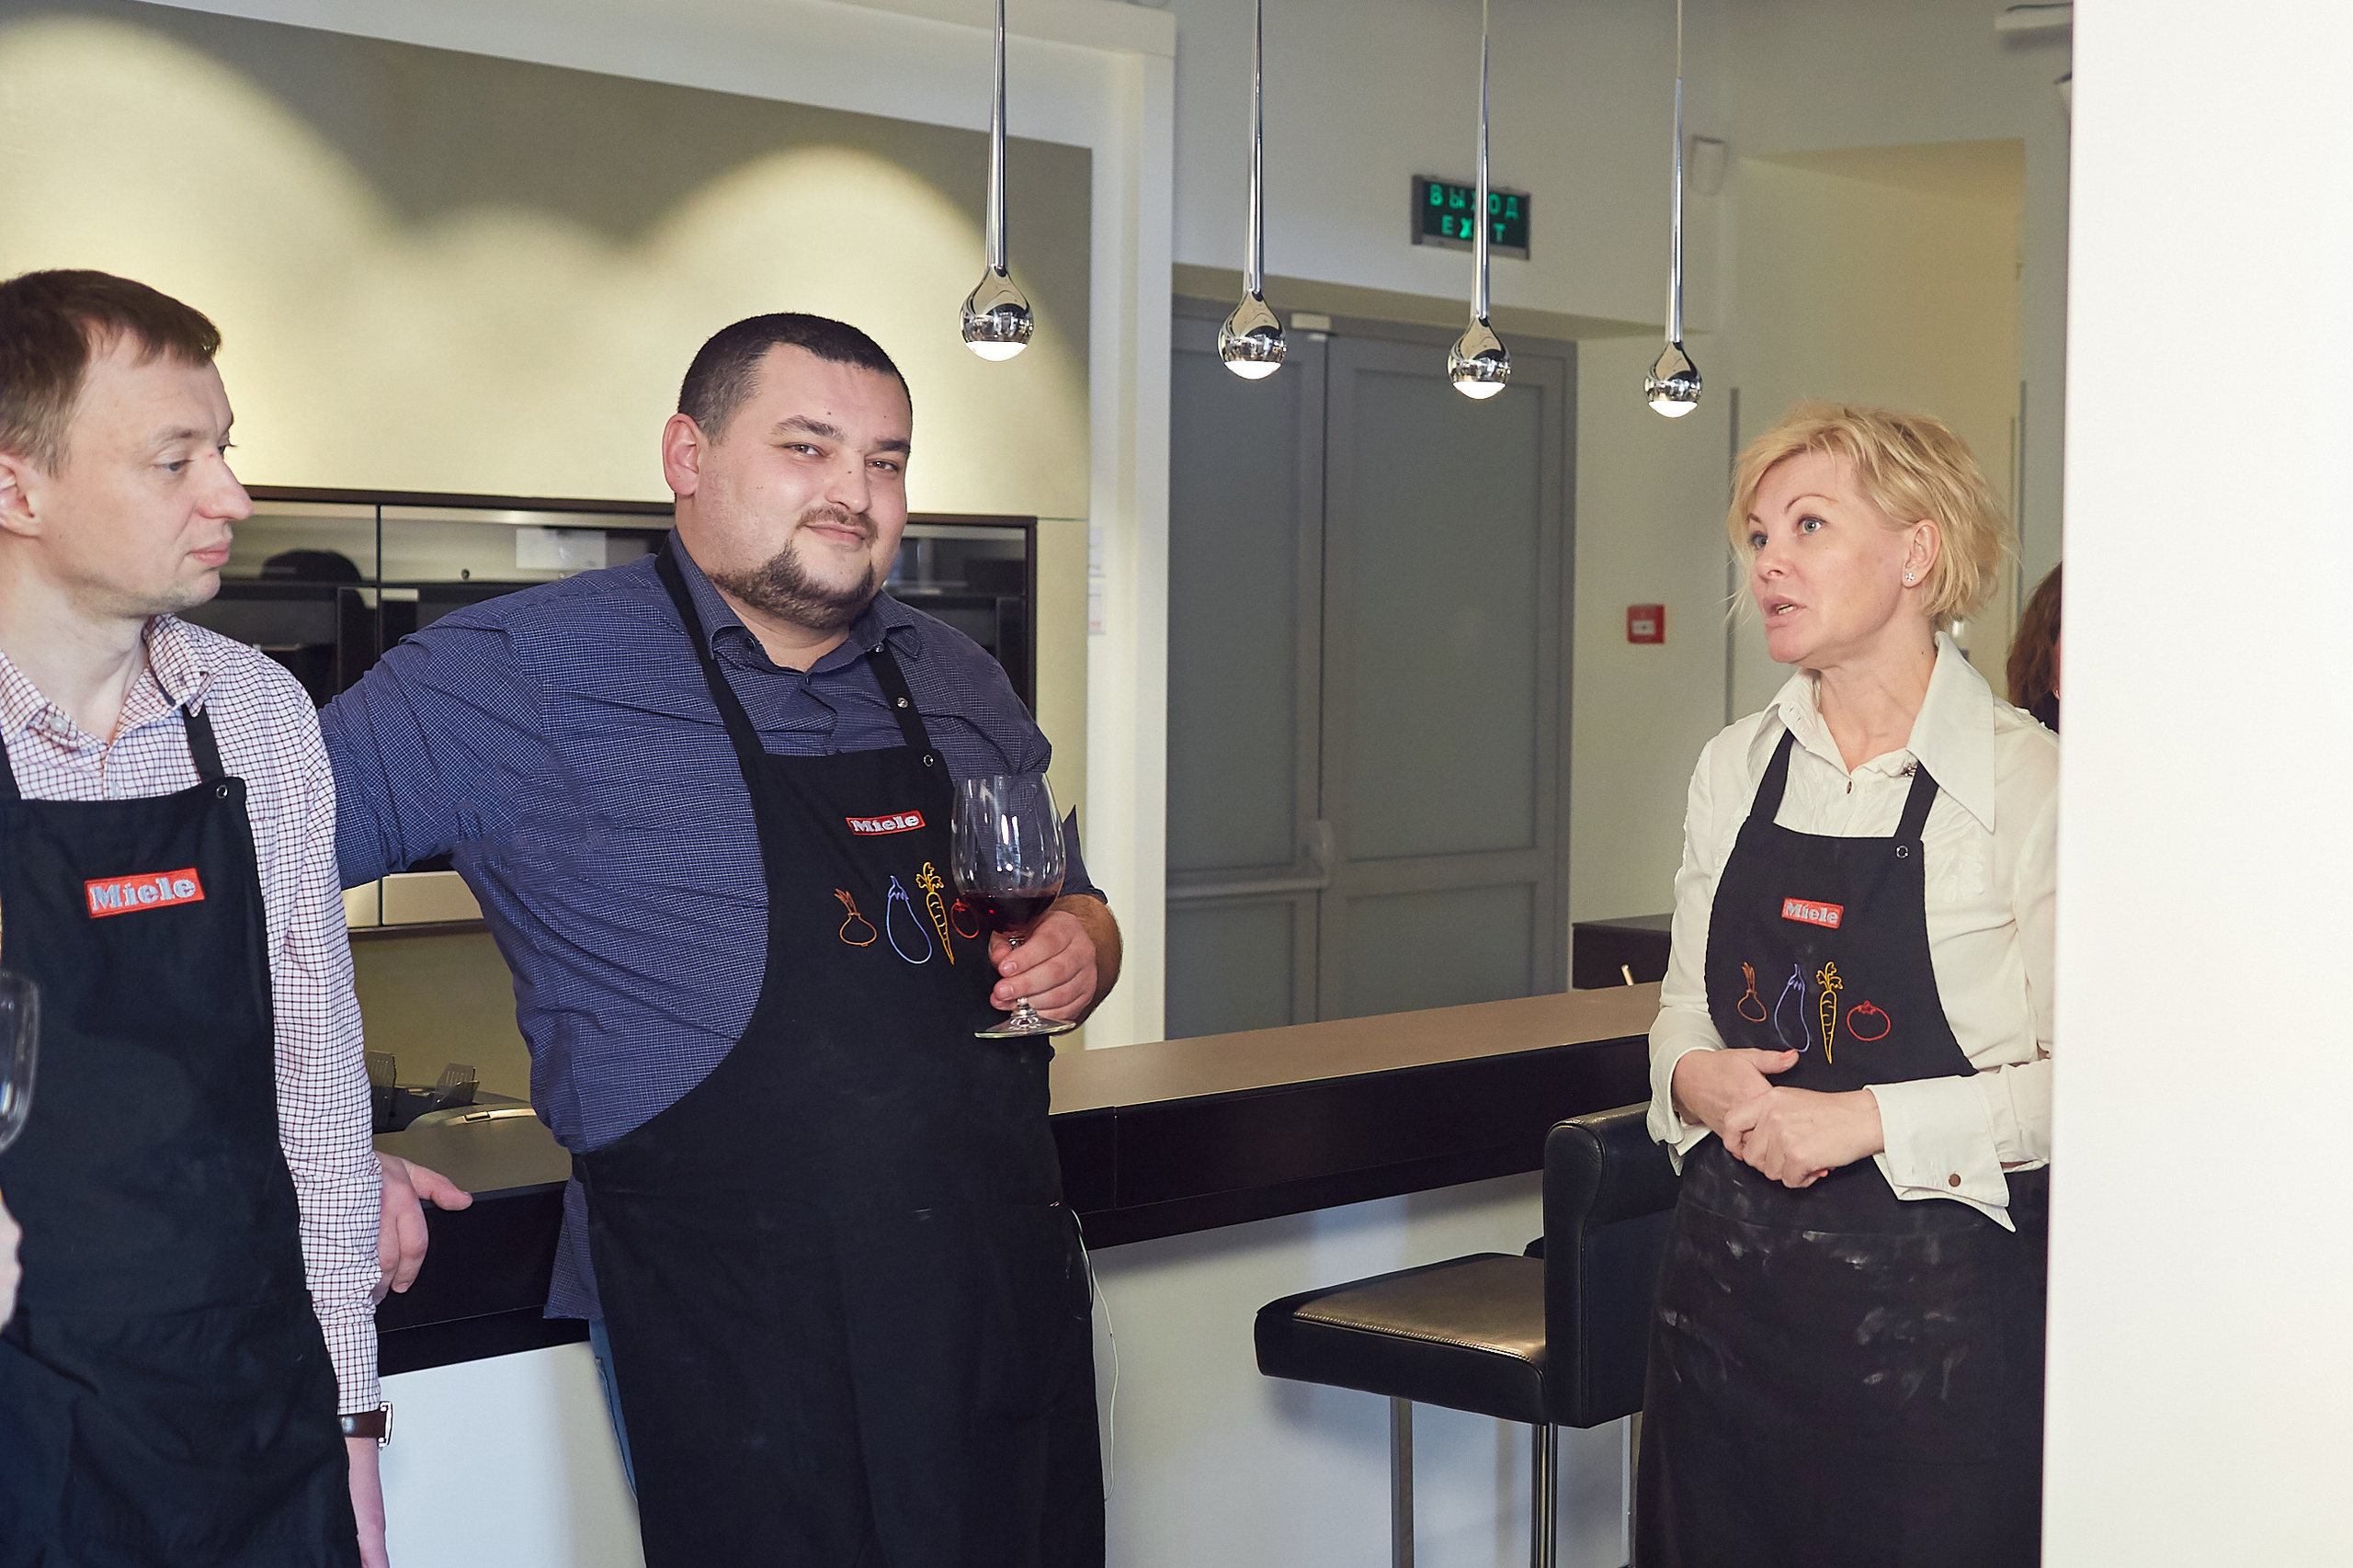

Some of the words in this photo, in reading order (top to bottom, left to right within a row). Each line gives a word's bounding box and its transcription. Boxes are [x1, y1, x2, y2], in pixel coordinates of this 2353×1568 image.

[1441, 214, 1506, 243] EXT
[850, 815, 919, 832] Miele
[90, 877, 196, 911] Miele
[1784, 902, 1838, 924] Miele
